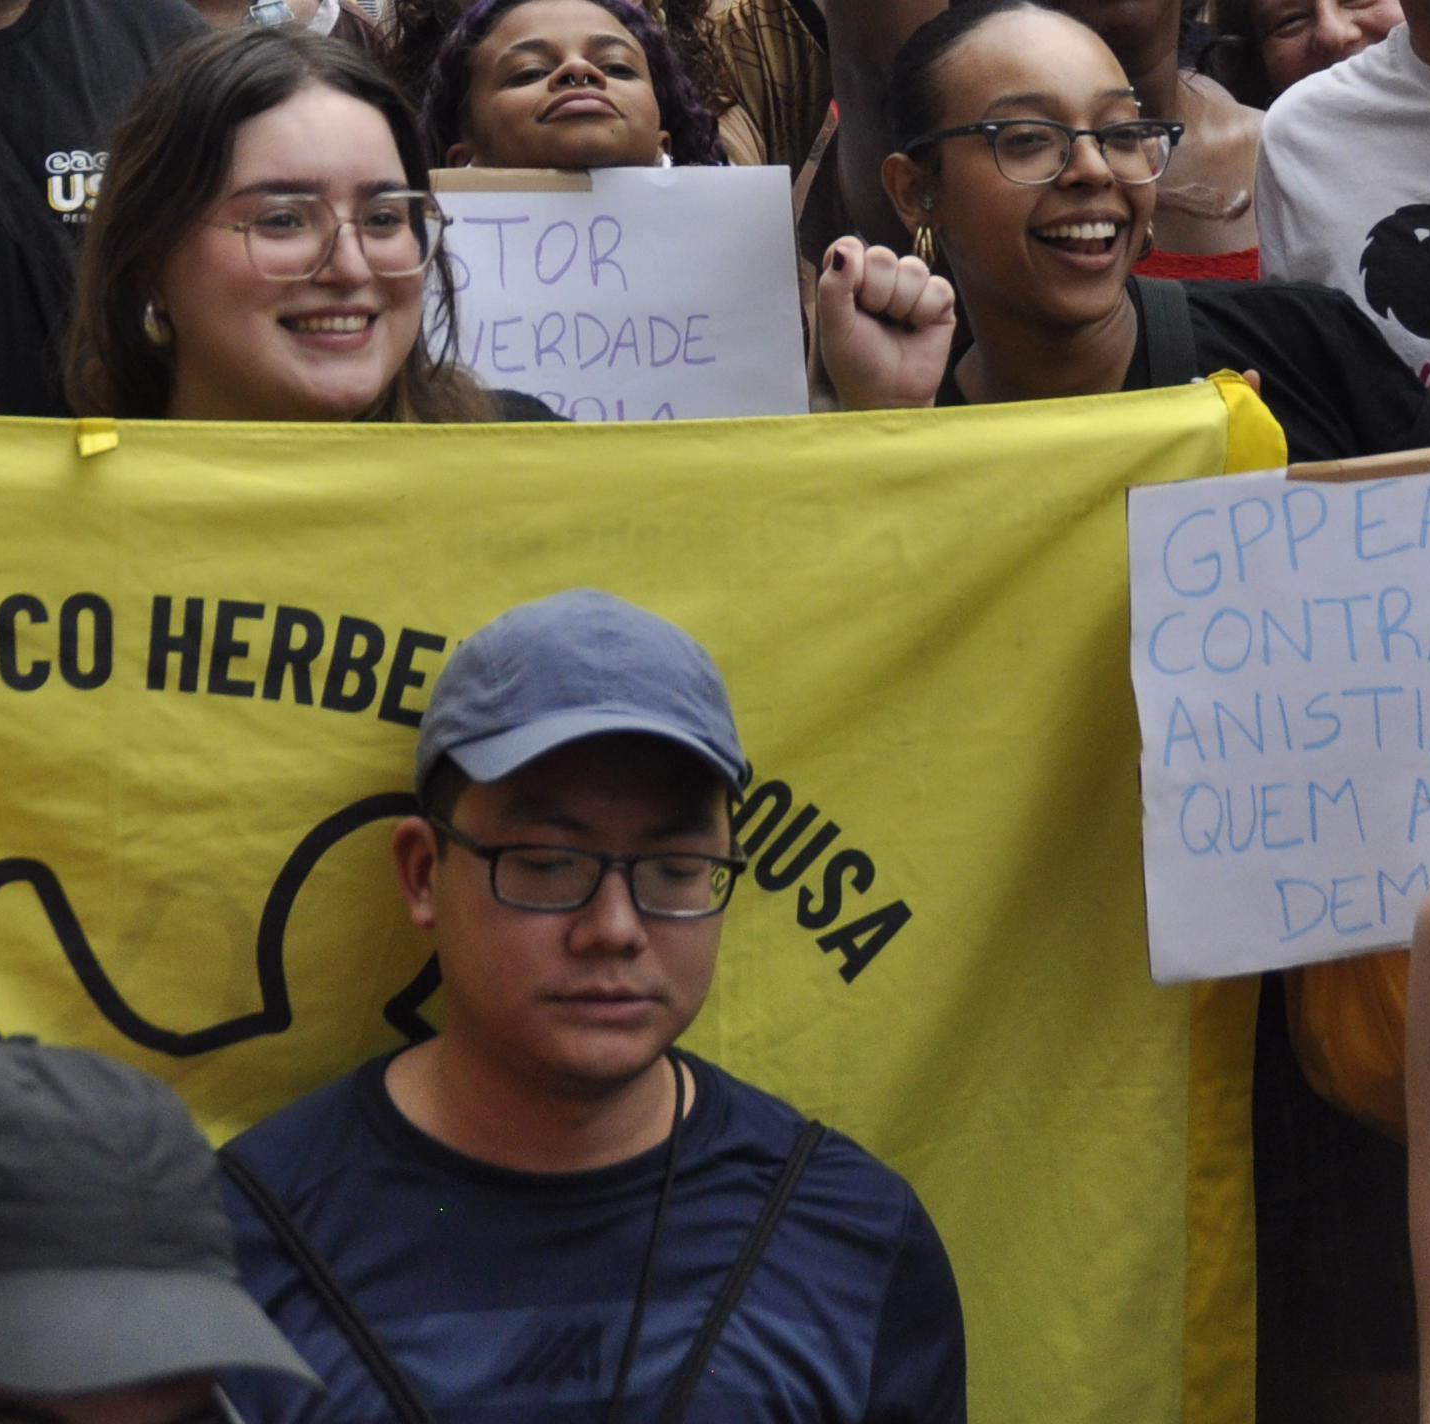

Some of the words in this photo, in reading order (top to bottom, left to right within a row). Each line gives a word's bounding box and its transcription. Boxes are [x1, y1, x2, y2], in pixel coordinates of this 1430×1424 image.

[1161, 486, 1330, 598] GPP
[147, 594, 463, 729] HERBE
[731, 766, 913, 985] OUSA
[1177, 776, 1367, 857] QUEM
